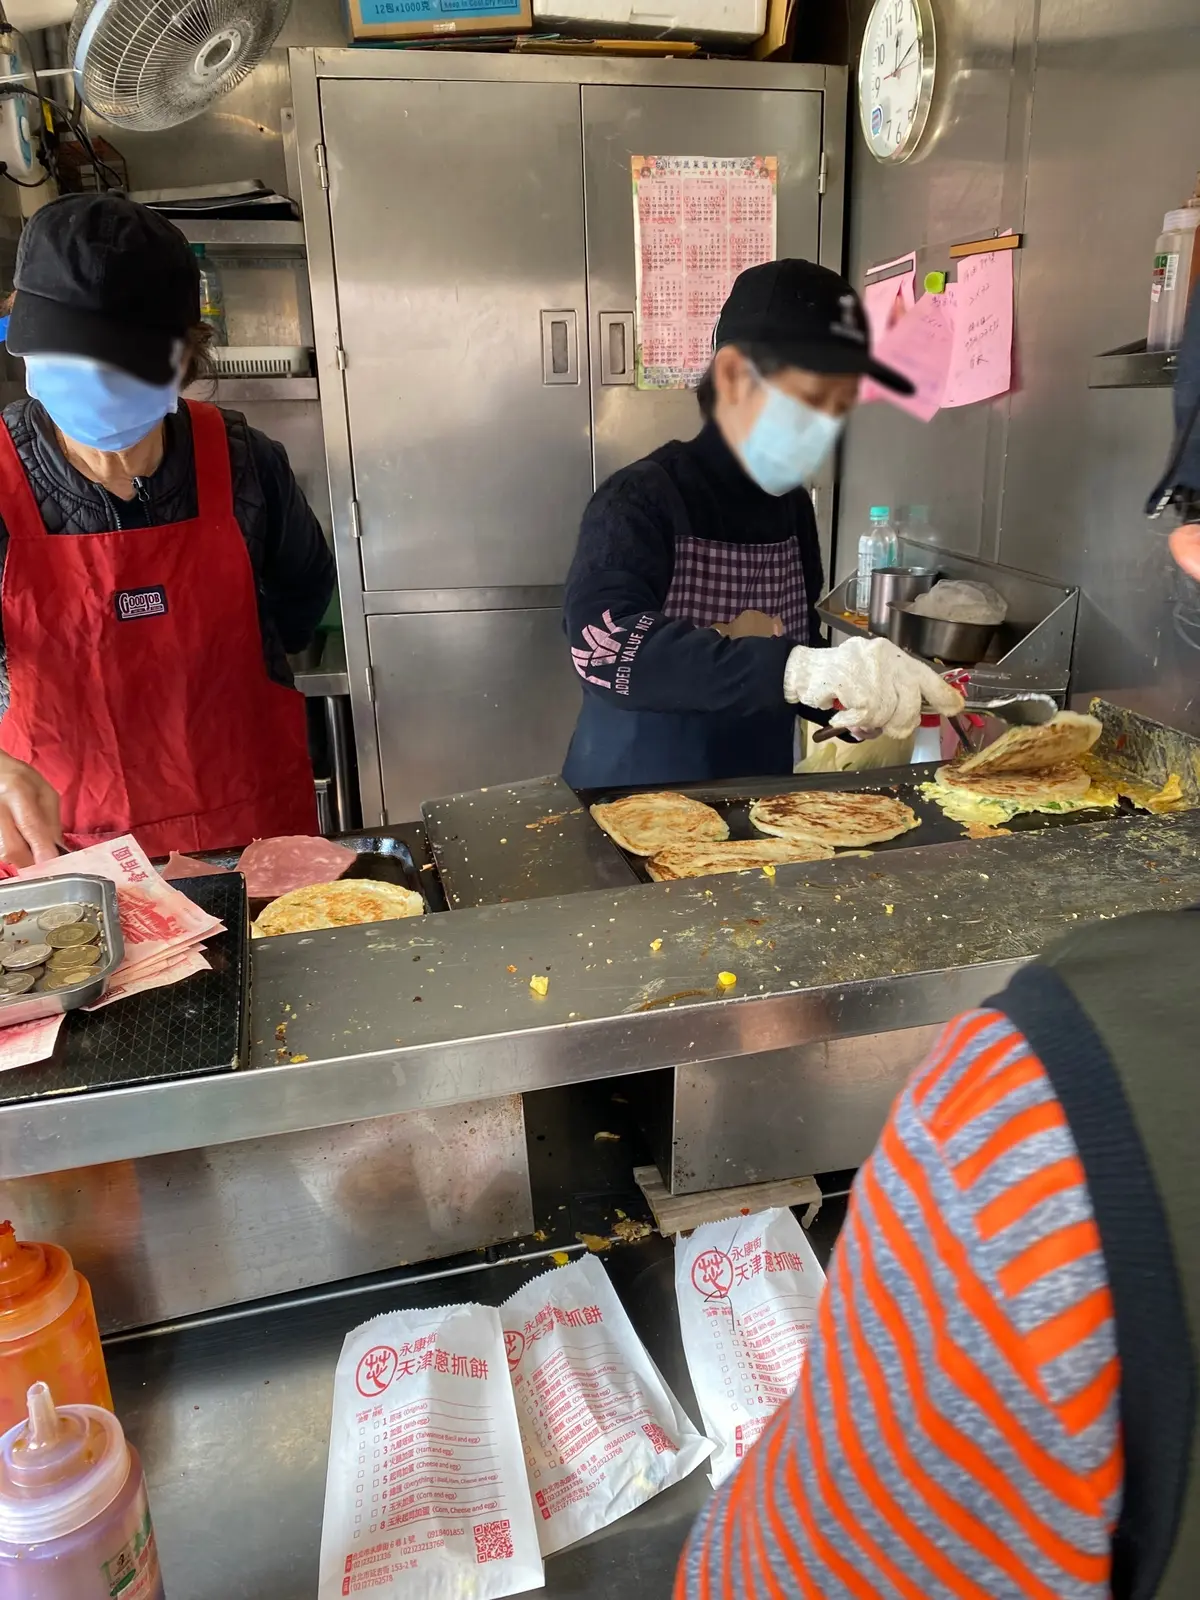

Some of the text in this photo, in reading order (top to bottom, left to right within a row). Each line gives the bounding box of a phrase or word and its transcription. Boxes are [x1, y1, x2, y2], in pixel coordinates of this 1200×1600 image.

[894, 0, 904, 25] 12
[884, 14, 893, 38] 11
[874, 43, 886, 67] 10
[874, 76, 881, 99] 9
[886, 119, 892, 142] 7
[896, 121, 902, 145] 6
[615, 615, 655, 696] ADDED VALUE NET
[731, 1236, 762, 1261] 永康街
[396, 1348, 489, 1381] 天津蔥抓餅
[754, 1383, 760, 1391] 7
[757, 1395, 764, 1404] 8
[382, 1417, 387, 1426] 1
[383, 1431, 388, 1441] 2
[383, 1445, 388, 1455] 3
[383, 1460, 388, 1469] 4
[383, 1475, 388, 1485] 5
[382, 1490, 388, 1500] 6
[382, 1505, 387, 1515] 7
[434, 1491, 444, 1499] and
[380, 1520, 386, 1530] 8
[427, 1528, 465, 1539] 0918401855
